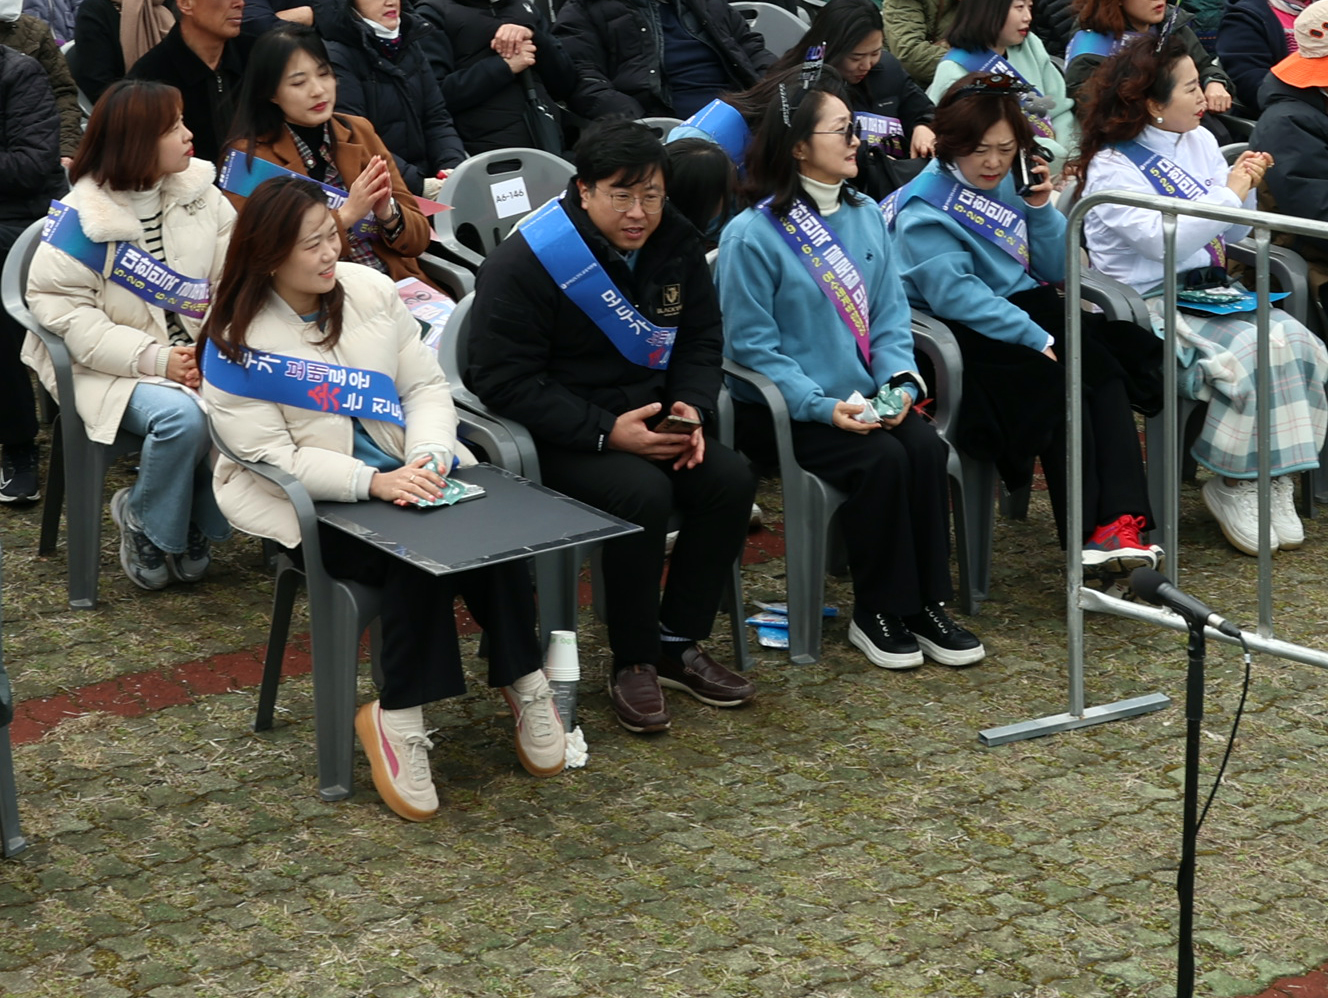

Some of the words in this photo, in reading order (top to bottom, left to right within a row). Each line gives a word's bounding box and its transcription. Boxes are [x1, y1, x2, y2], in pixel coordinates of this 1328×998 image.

[496, 189, 524, 203] A6-146
[958, 188, 1018, 228] 대한민국
[789, 199, 833, 247] 한민국
[953, 203, 985, 225] 5.29
[994, 228, 1017, 246] 6.2
[120, 248, 180, 292] 대한민국
[801, 243, 822, 268] 6.2
[114, 268, 145, 290] 5.29
[155, 292, 178, 305] 6.2
[600, 289, 651, 335] 모두가
[285, 360, 370, 389] 보배로운
[307, 382, 364, 411] 솟는
[372, 397, 404, 421] 진도
